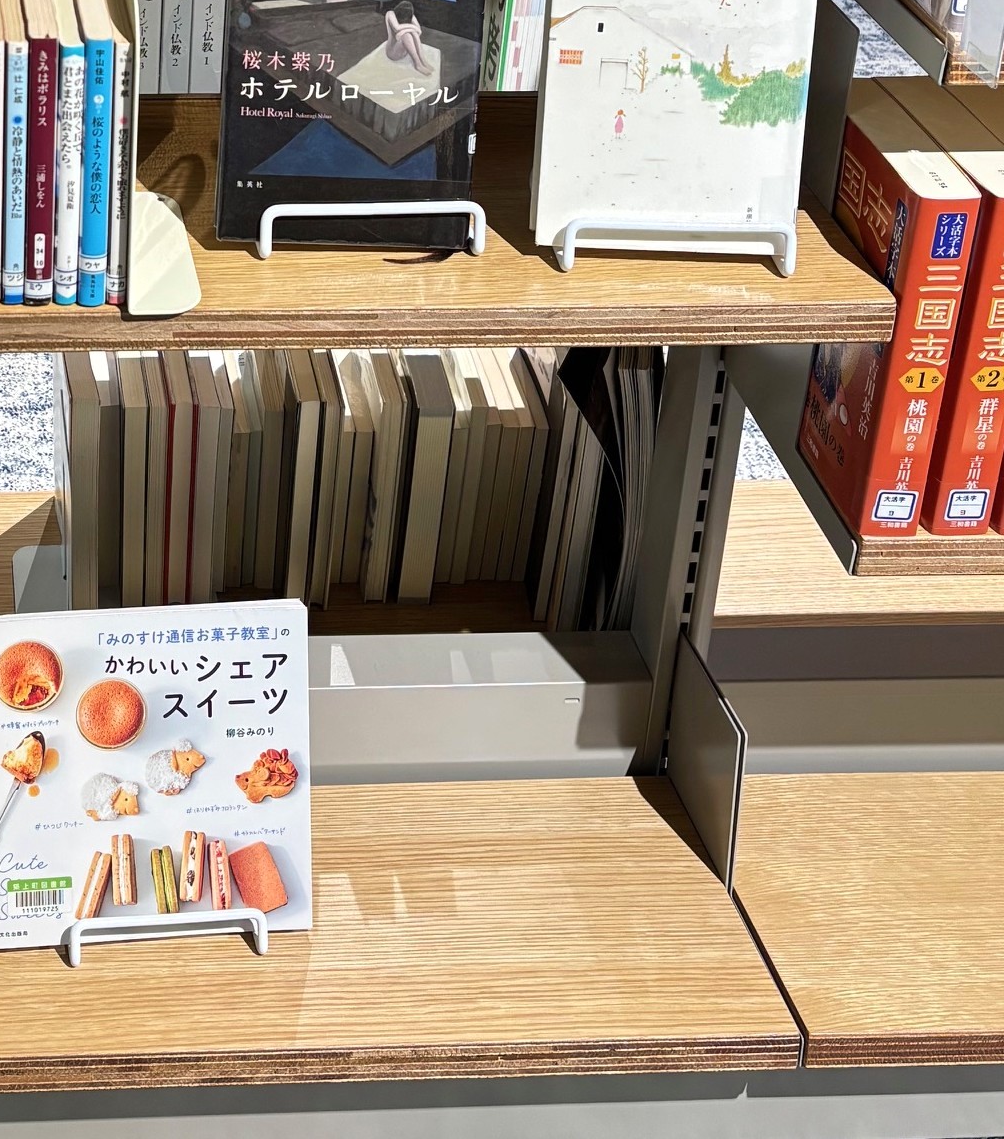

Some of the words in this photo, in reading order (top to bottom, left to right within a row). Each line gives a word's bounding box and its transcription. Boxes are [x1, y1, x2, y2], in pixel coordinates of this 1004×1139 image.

[170, 4, 183, 56] インド仏教
[201, 3, 214, 53] インド仏教
[95, 49, 105, 85] 宇山佳佑
[172, 58, 179, 67] 2
[204, 56, 209, 66] 1
[242, 49, 335, 73] 桜木紫乃
[37, 50, 50, 127] きみはポラリス
[240, 76, 459, 107] ホテルローヤル
[60, 66, 75, 169] 君とまた出会えたら。
[240, 107, 265, 118] Hotel
[267, 107, 293, 120] Royal
[11, 125, 24, 212] 冷静と情熱のあいだ
[90, 116, 105, 214] 桜のような僕の恋人
[35, 163, 47, 209] 三浦しをん
[236, 180, 264, 190] 集英社
[934, 214, 952, 257] シリーズ
[947, 214, 965, 258] 大活字本
[905, 265, 963, 366] 三国志
[905, 371, 940, 389] 第1巻
[904, 399, 929, 452] 桃園の巻
[974, 398, 999, 450] 群星の巻
[895, 457, 914, 491] 吉川英
[965, 456, 985, 491] 吉川英
[97, 626, 290, 646] 「みのすけ通信お菓子教室」の
[105, 653, 289, 682] かわいいシェア
[162, 688, 289, 719] スイーツ
[226, 727, 275, 738] 柳谷みのり
